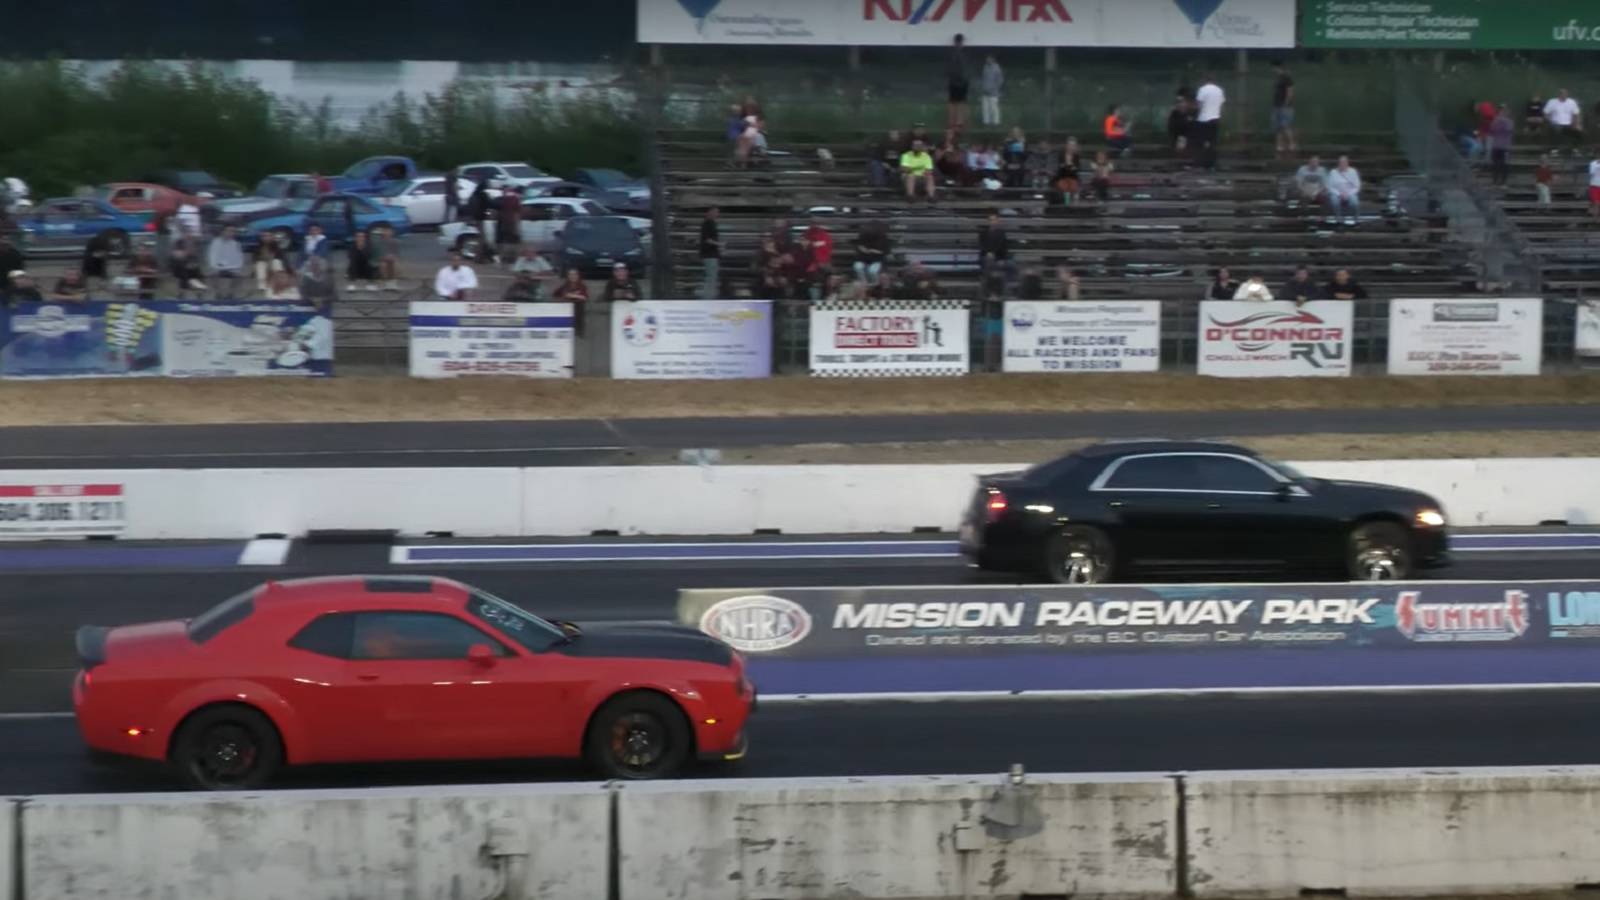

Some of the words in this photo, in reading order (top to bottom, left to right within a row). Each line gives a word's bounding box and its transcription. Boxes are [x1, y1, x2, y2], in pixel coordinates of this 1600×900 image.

[835, 316, 914, 331] FACTORY
[1038, 335, 1058, 346] WE
[1062, 335, 1128, 346] WELCOME
[1206, 328, 1343, 341] O'CONNOR
[1007, 348, 1030, 358] ALL
[1034, 347, 1088, 358] RACERS
[1092, 347, 1119, 357] AND
[1123, 347, 1158, 357] FANS
[1290, 342, 1344, 368] RV
[1042, 360, 1060, 369] TO
[1063, 359, 1122, 369] MISSION
[832, 602, 1024, 628] MISSION
[1035, 599, 1254, 626] RACEWAY
[1260, 598, 1381, 624] PARK
[720, 607, 793, 640] NHRA
[866, 634, 926, 646] Owned
[929, 634, 961, 645] and
[966, 634, 1041, 646] operated
[1045, 633, 1068, 646] by
[1072, 633, 1102, 643] the
[1142, 631, 1212, 643] Custom
[1214, 630, 1247, 642] Car
[1250, 630, 1346, 641] Association
